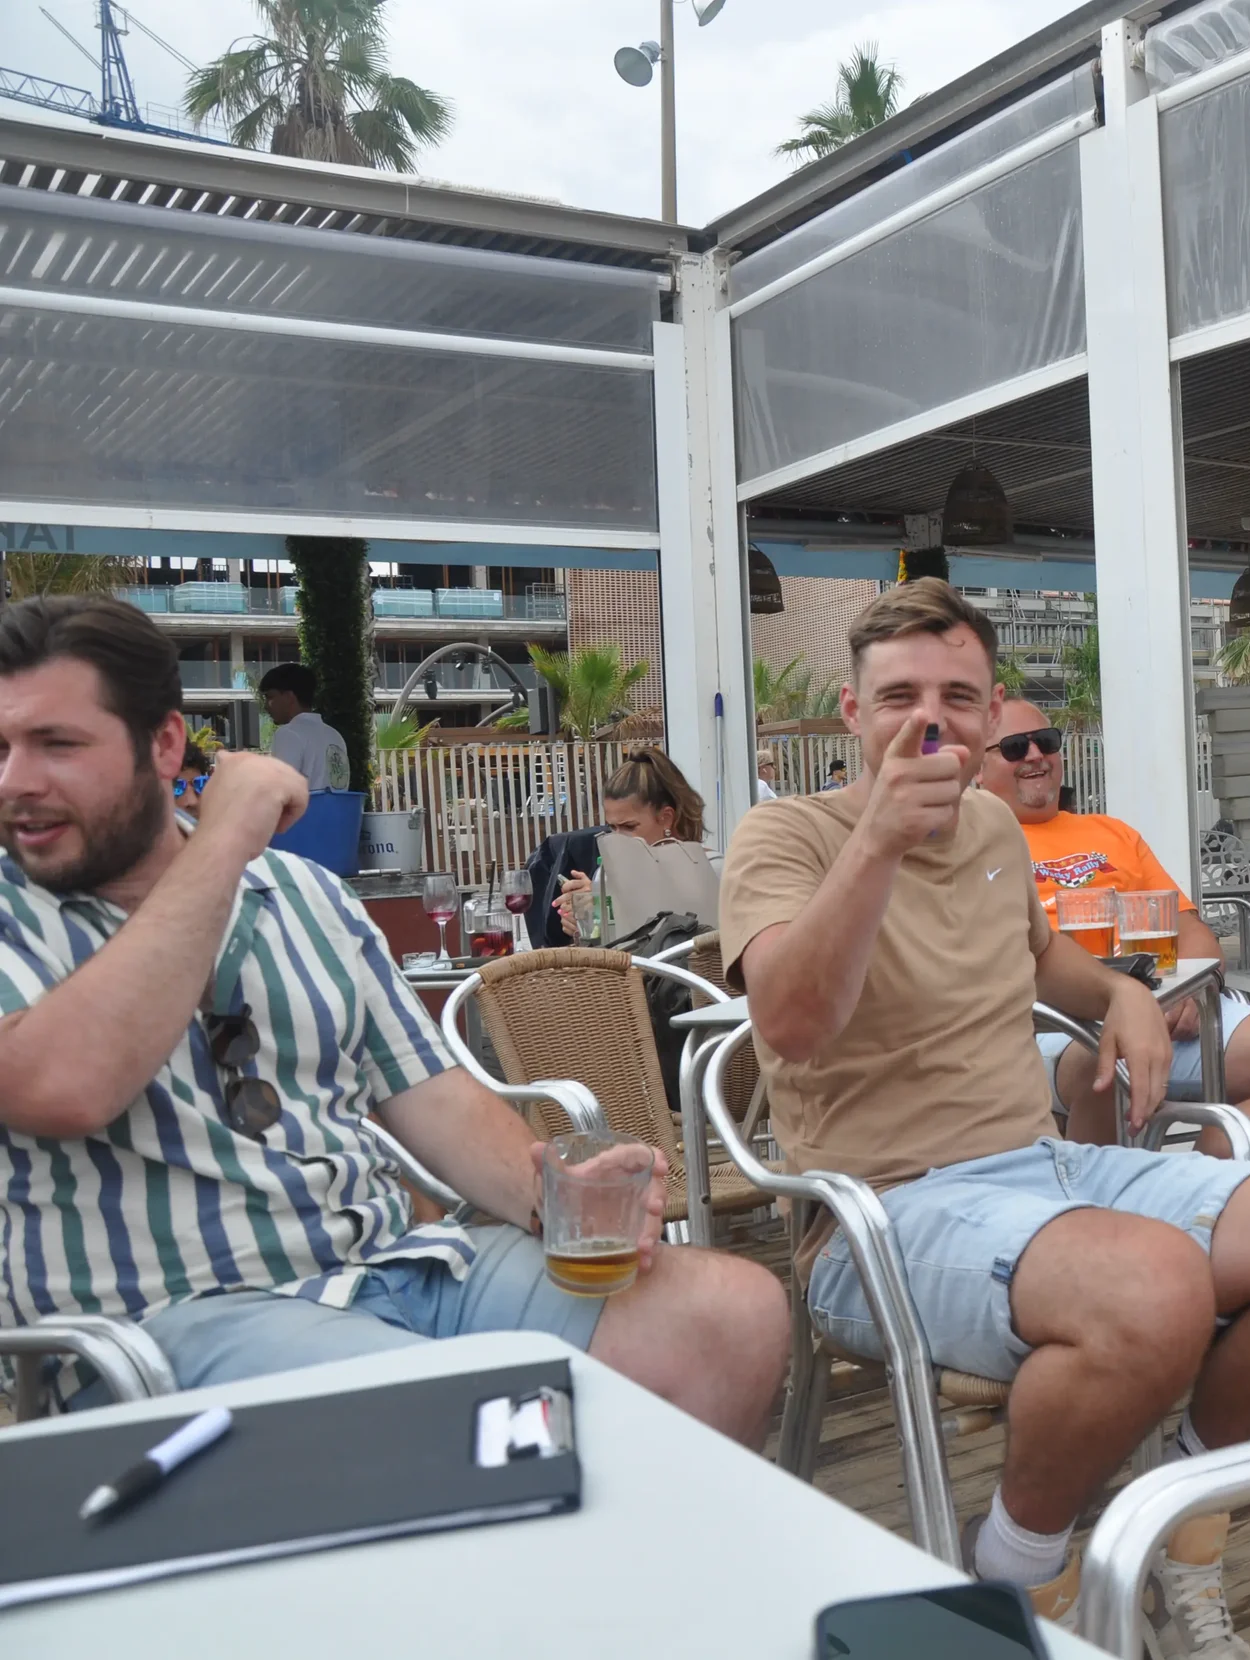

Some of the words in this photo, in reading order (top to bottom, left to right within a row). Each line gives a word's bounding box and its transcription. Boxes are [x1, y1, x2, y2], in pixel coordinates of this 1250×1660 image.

[361, 842, 394, 855] rona
[1039, 868, 1071, 880] Wacky
[1073, 860, 1100, 876] Rally
